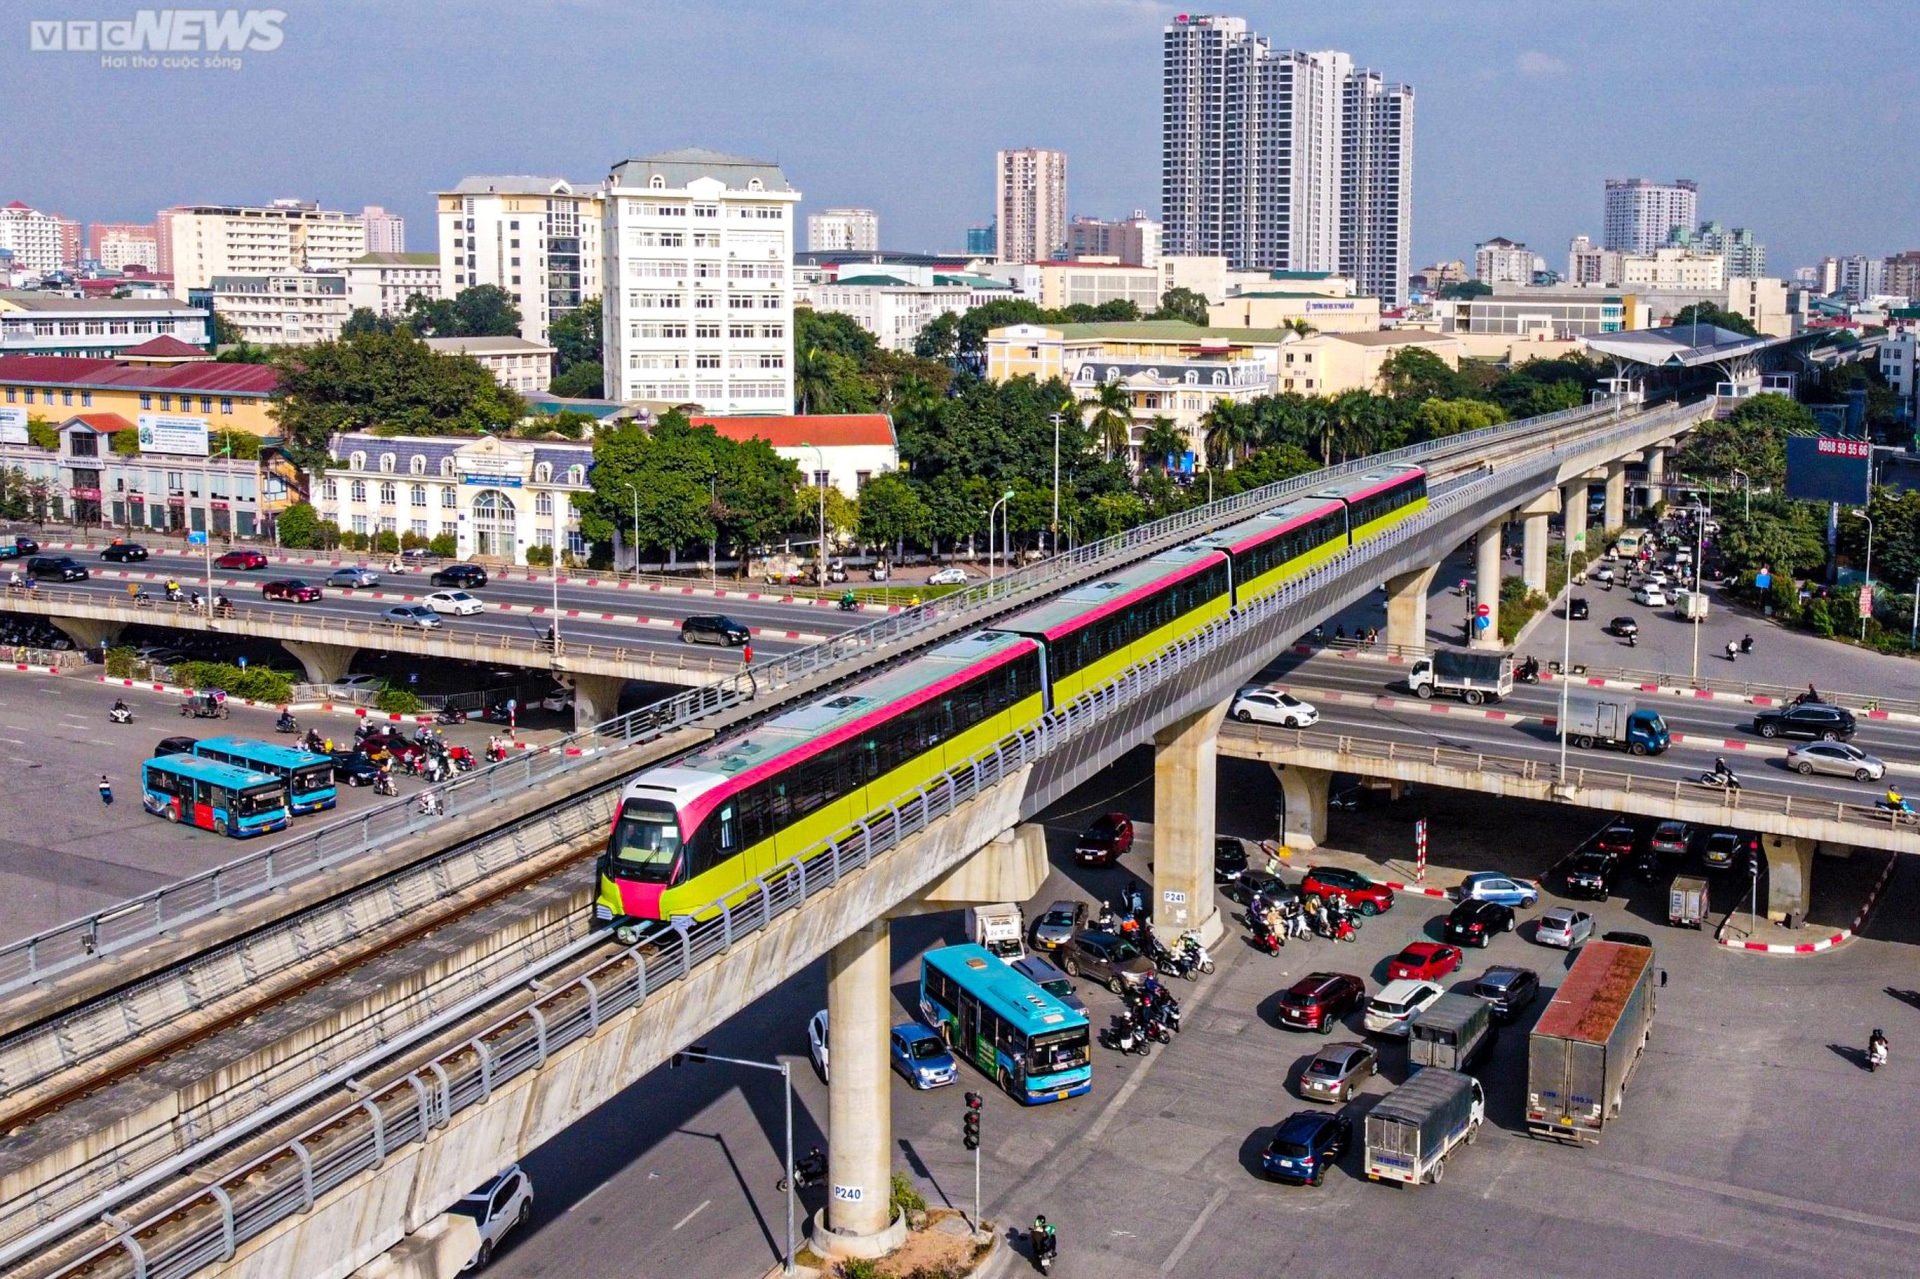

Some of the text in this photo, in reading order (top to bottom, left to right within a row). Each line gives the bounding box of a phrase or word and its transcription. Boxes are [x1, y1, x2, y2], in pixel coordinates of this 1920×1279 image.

[1818, 440, 1836, 452] 0988
[1848, 443, 1857, 455] 55
[1165, 892, 1184, 901] P241
[835, 1186, 861, 1199] P240
